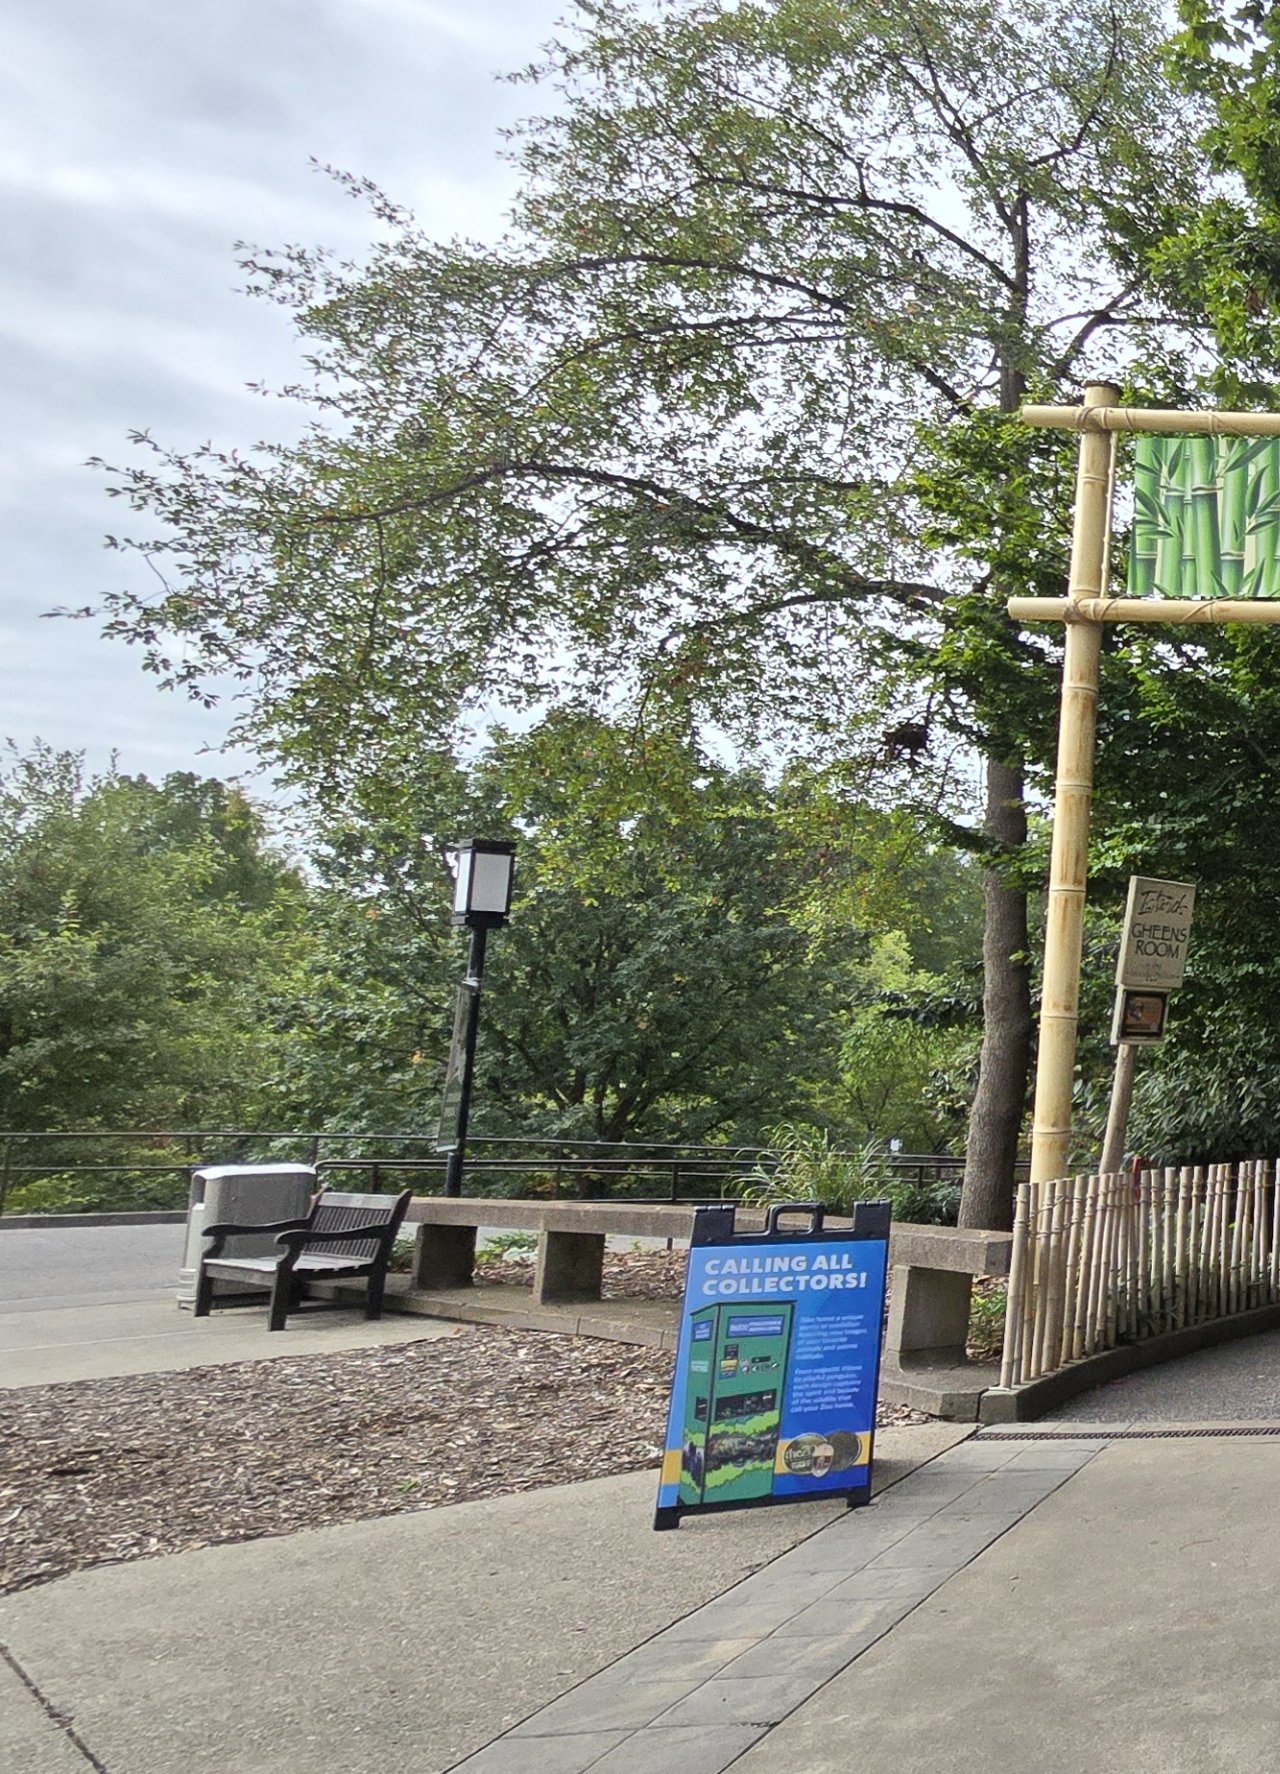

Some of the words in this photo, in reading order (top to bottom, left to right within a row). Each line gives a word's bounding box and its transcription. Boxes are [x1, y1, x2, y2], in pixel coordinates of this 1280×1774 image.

[1132, 923, 1187, 943] GHEENS
[1135, 940, 1180, 959] ROOM
[705, 1255, 806, 1275] CALLING
[811, 1254, 852, 1271] ALL
[702, 1272, 867, 1296] COLLECTORS!
